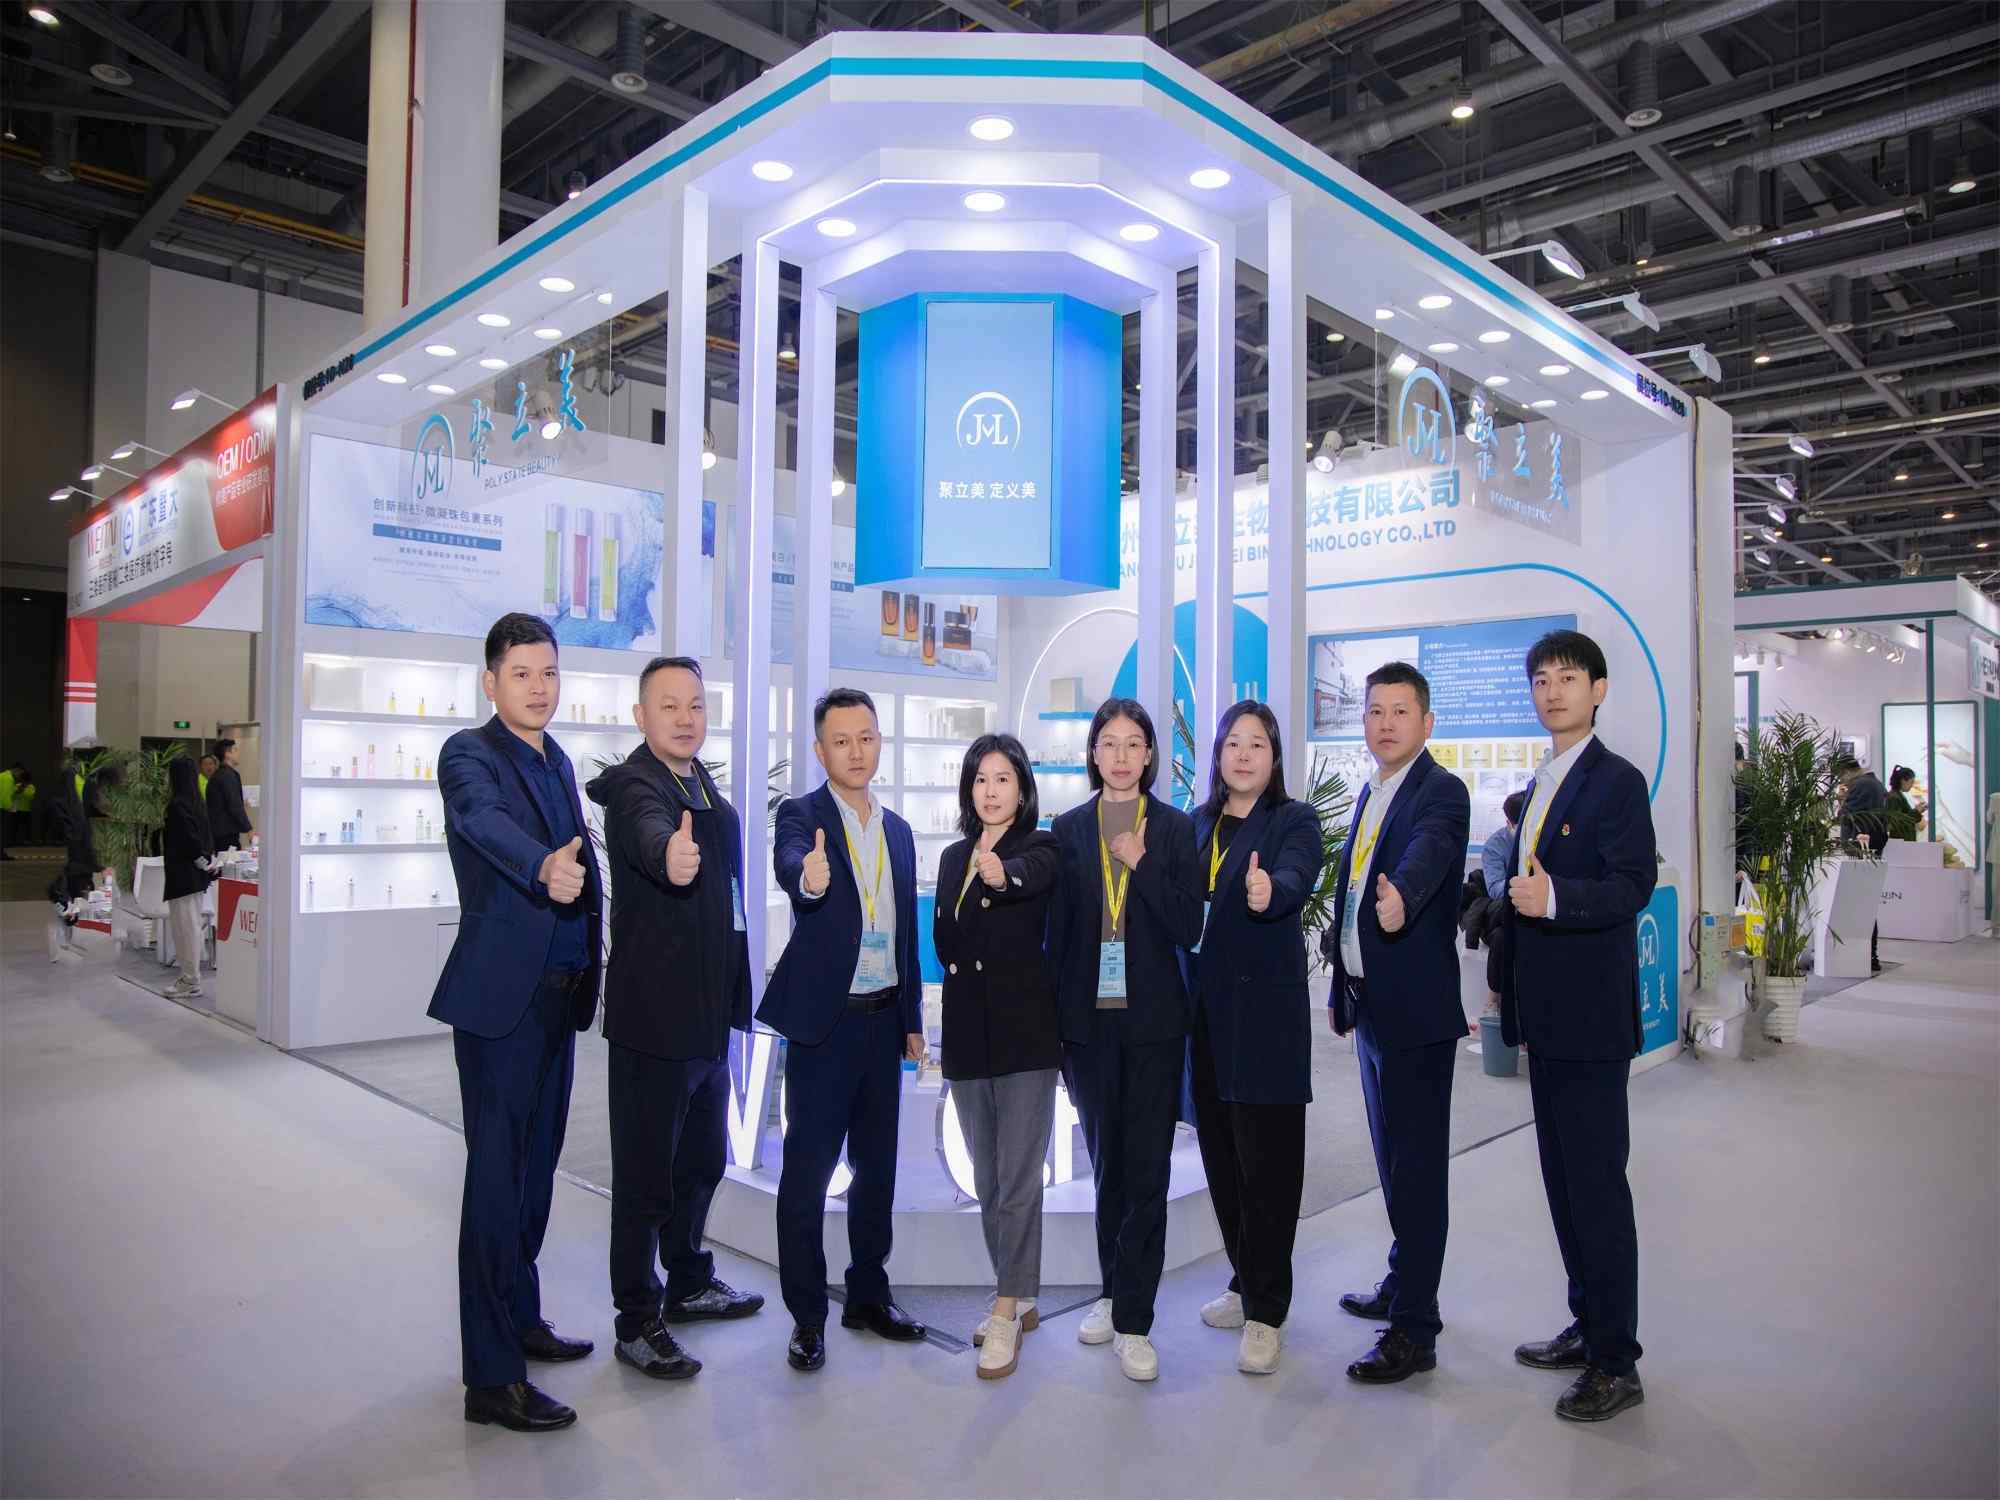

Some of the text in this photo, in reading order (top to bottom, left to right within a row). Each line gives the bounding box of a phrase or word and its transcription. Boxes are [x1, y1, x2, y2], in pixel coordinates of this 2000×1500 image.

[938, 481, 1036, 499] 聚立美 定义美
